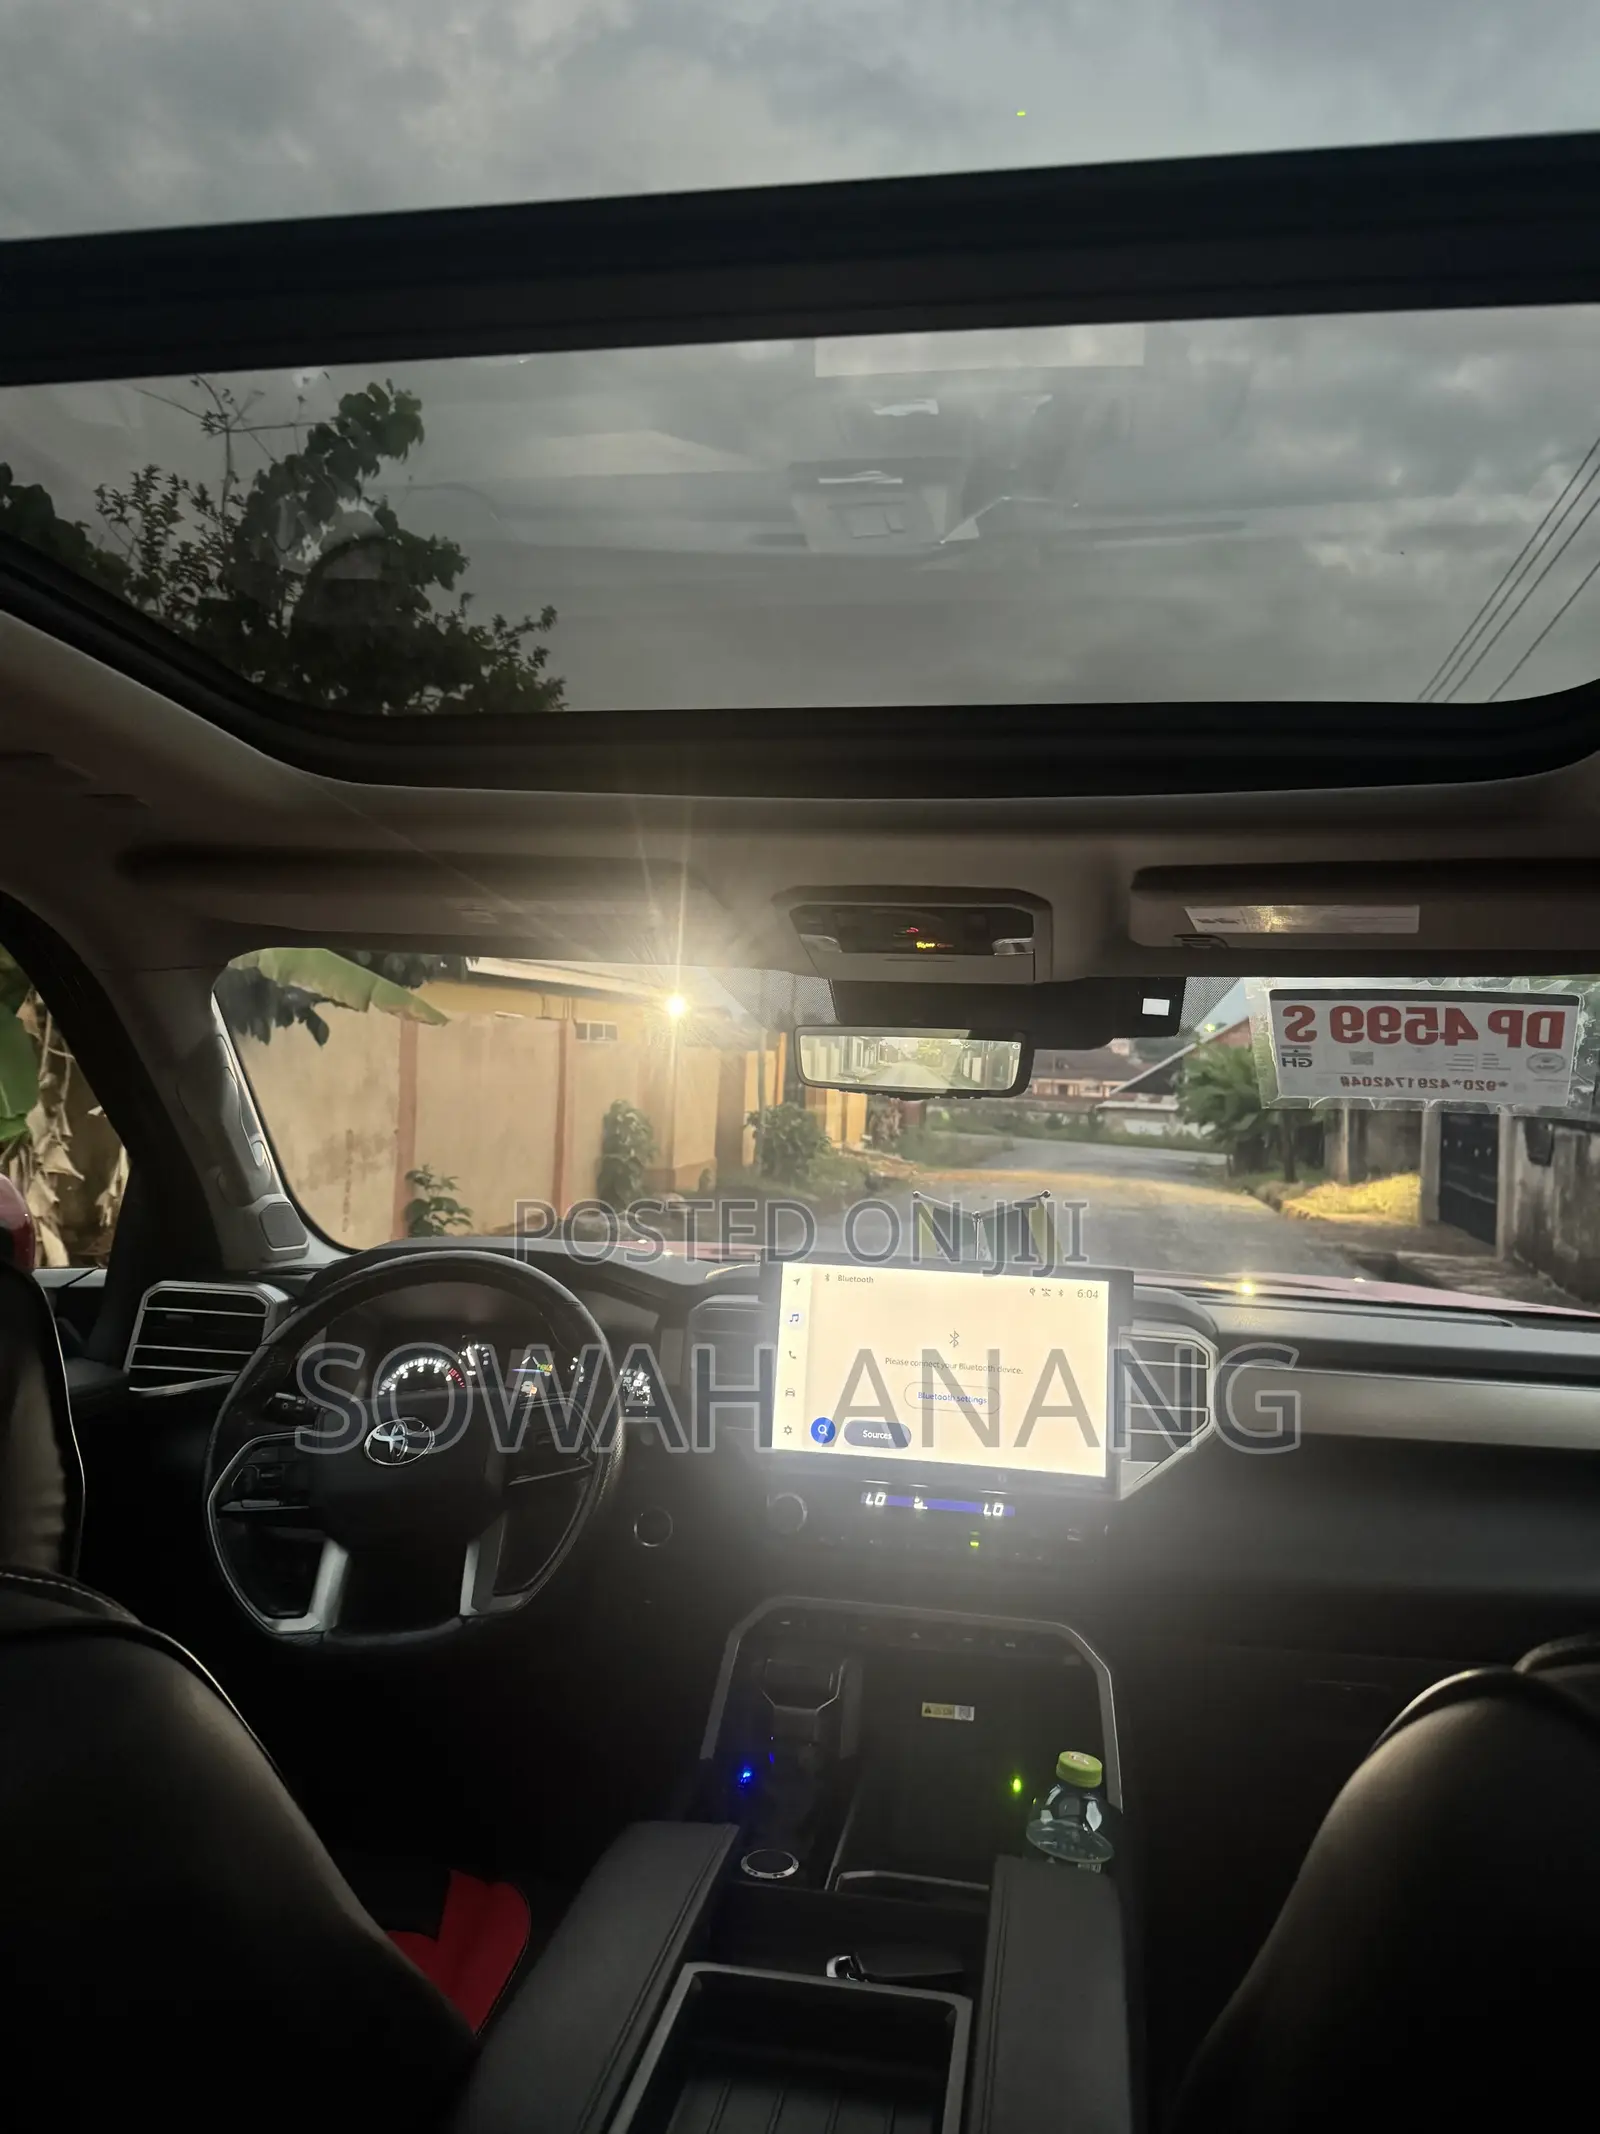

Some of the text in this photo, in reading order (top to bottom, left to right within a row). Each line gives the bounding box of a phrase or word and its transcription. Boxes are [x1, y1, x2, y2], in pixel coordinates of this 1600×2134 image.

[837, 1274, 874, 1284] Bluetooth
[1077, 1289, 1099, 1299] 6:04
[885, 1357, 909, 1366] Please
[910, 1360, 940, 1369] connect
[958, 1362, 995, 1373] Bluetooth
[918, 1391, 955, 1401] Bluetooth
[862, 1429, 893, 1440] Sources
